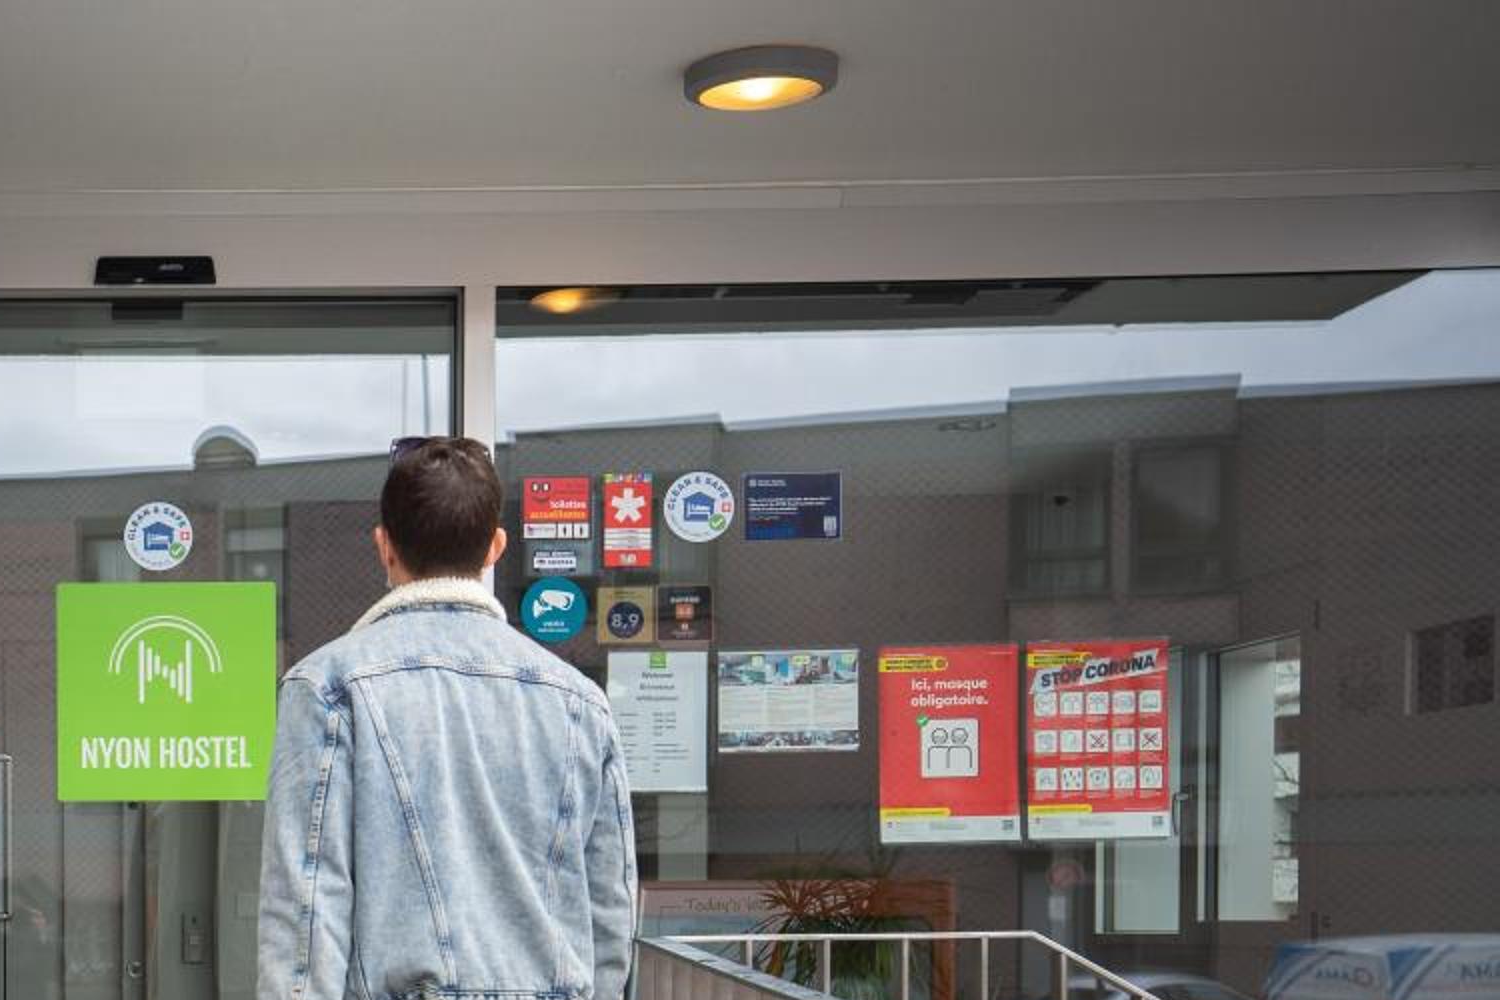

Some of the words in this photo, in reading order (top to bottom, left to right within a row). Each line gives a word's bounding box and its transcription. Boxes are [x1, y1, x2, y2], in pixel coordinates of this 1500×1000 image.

[127, 508, 150, 541] CLEAN
[163, 506, 188, 529] SAFE
[611, 613, 640, 632] 8,9
[1040, 664, 1083, 688] STOP
[1085, 655, 1156, 681] CORONA
[911, 678, 932, 693] Ici,
[935, 678, 988, 695] masque
[910, 693, 989, 709] obligatoire.
[80, 736, 151, 769] NYON
[159, 736, 253, 769] HOSTEL
